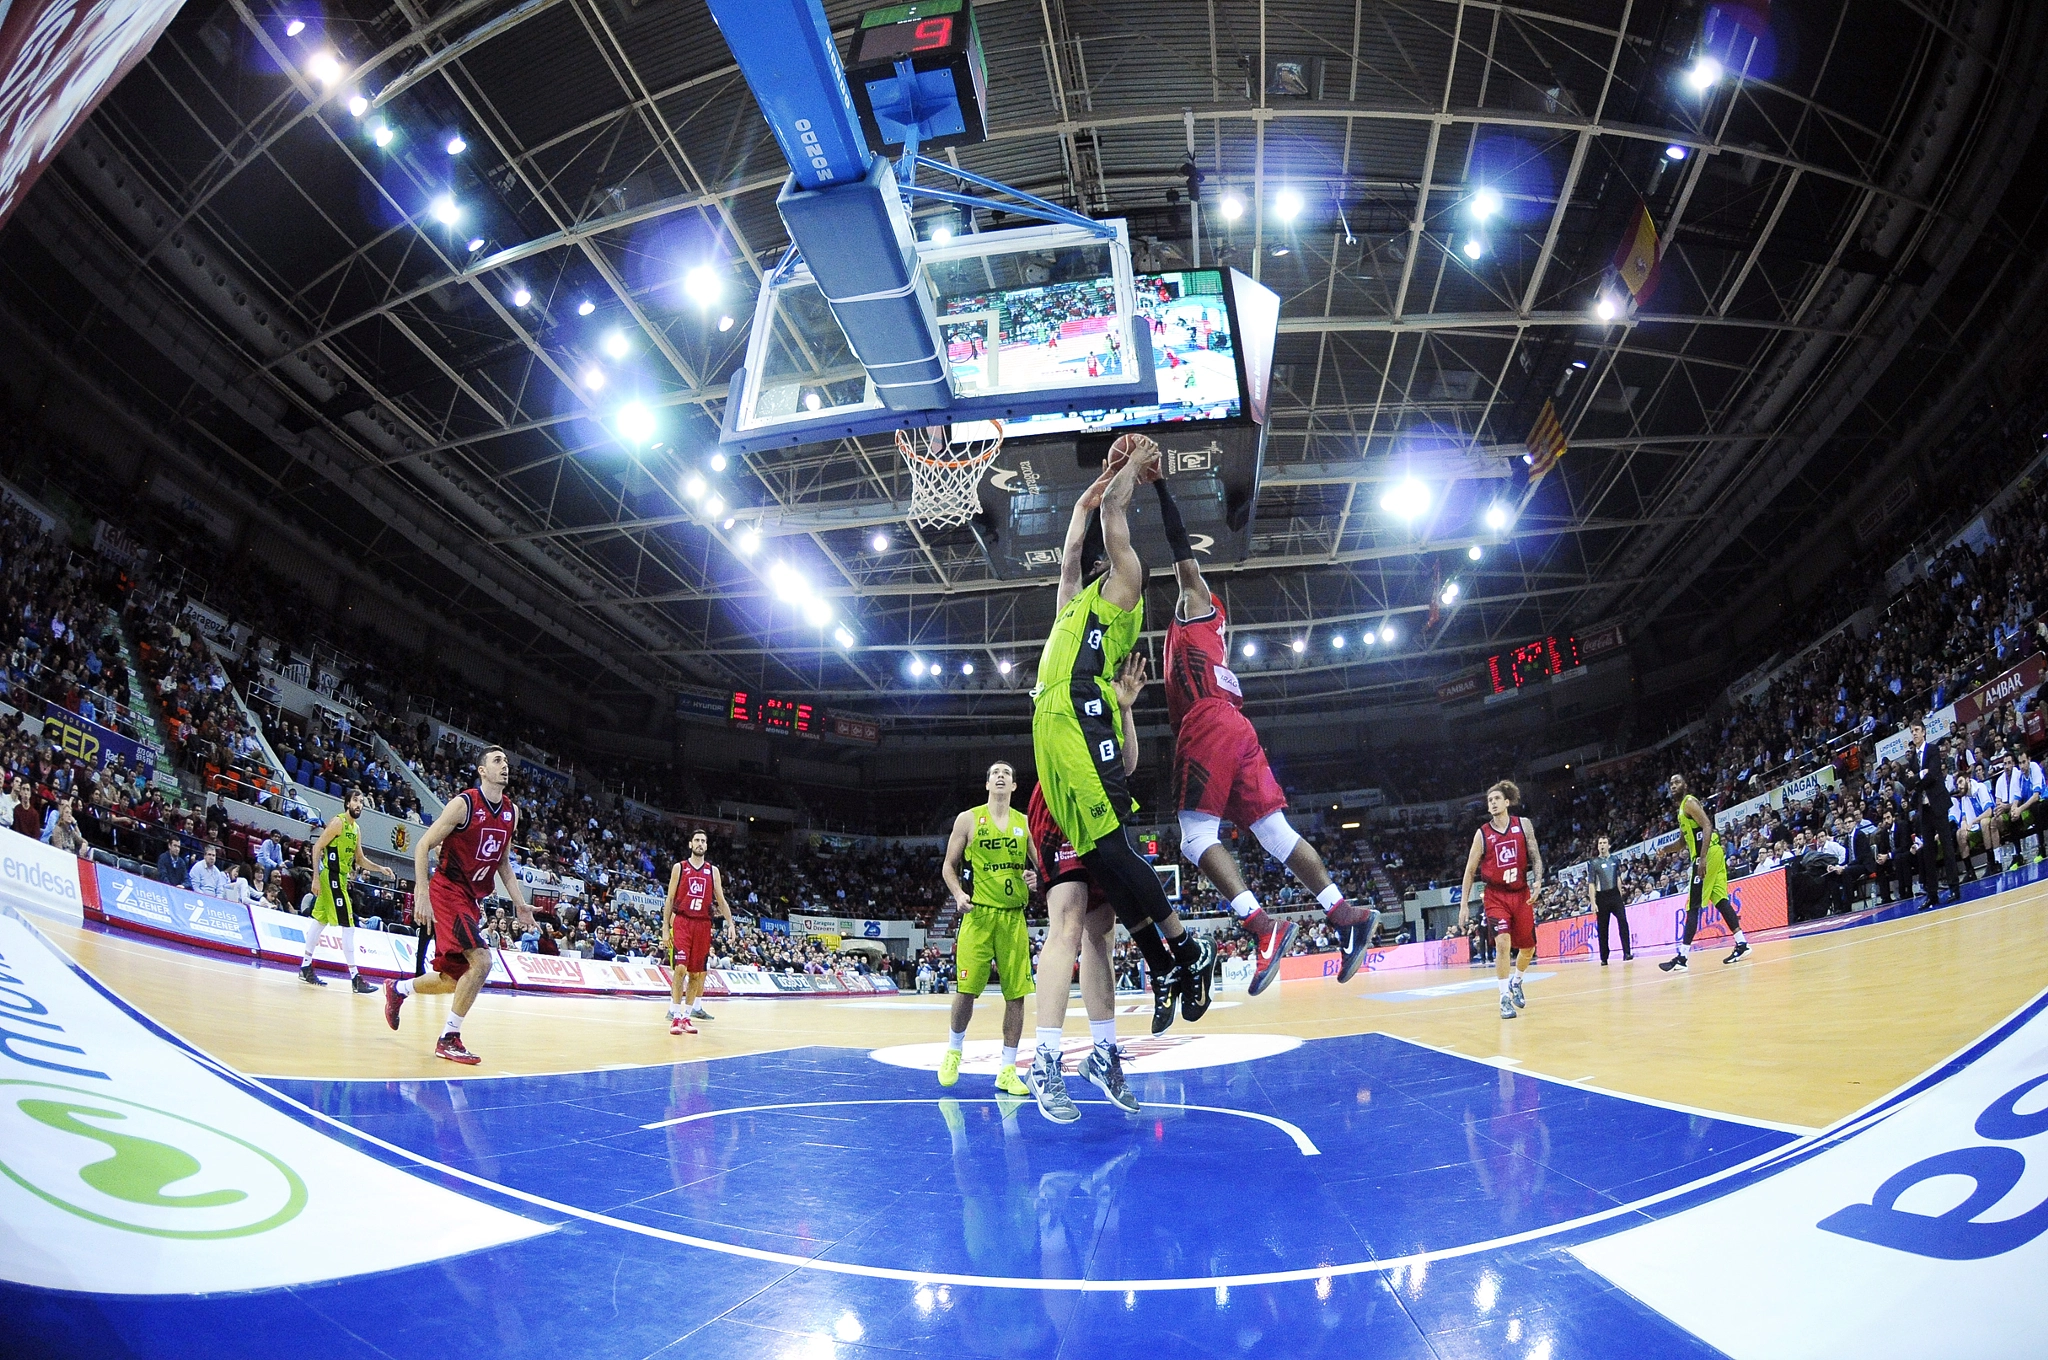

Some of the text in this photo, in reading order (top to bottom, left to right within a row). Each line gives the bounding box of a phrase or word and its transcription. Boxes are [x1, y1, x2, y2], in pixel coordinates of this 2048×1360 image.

[912, 17, 953, 52] 9
[826, 36, 851, 110] MONDO
[794, 118, 834, 182] MONDO
[187, 605, 227, 634] Zaragoza
[1445, 680, 1475, 696] AMBAR
[1985, 672, 2024, 707] AMBAR
[57, 711, 93, 732] CADENA
[1781, 774, 1818, 799] ANAGAN
[3, 857, 77, 899] endesa
[472, 865, 491, 882] 19
[1503, 868, 1518, 883] 42
[136, 887, 168, 905] inelsa
[1004, 878, 1014, 896] 8
[139, 900, 170, 915] ZENER
[207, 906, 238, 922] inelsa
[690, 899, 703, 911] 15
[210, 919, 241, 932] ZENER
[727, 972, 762, 985] DKV
